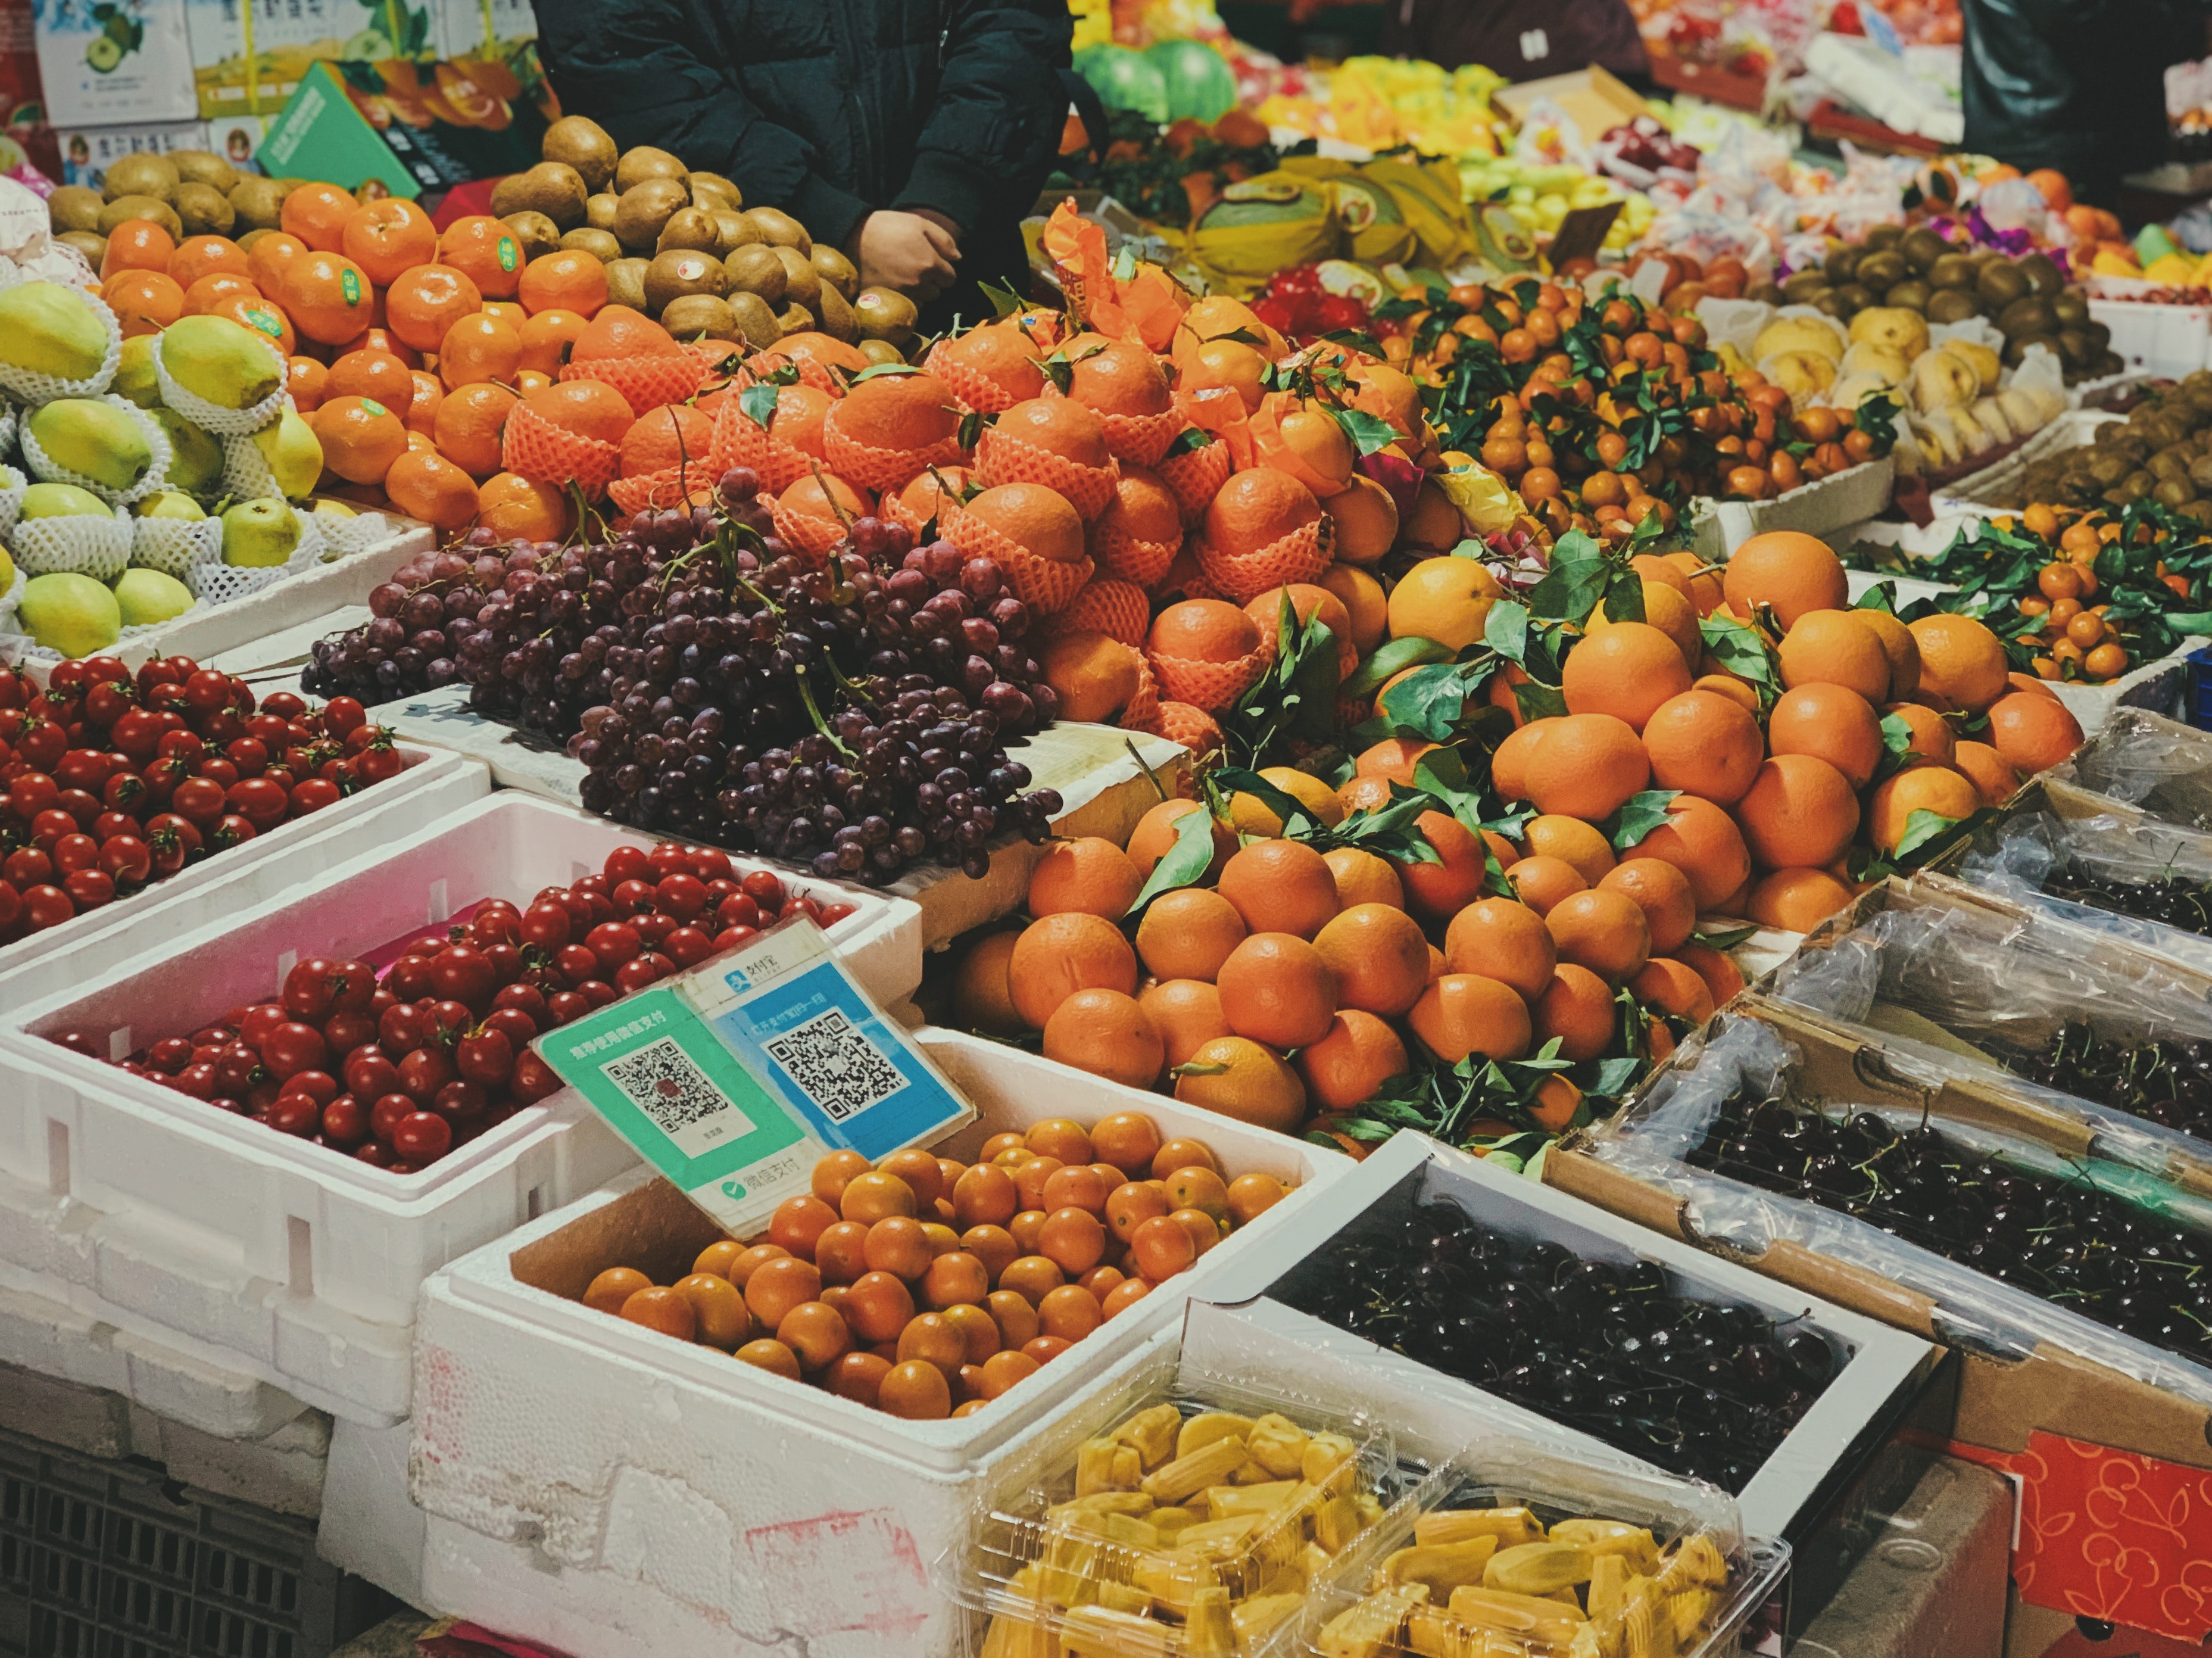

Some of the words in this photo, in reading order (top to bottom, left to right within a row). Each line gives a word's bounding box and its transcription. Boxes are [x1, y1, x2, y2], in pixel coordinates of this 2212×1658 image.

[745, 955, 778, 977] 支付宝
[569, 1010, 666, 1060] 推荐使用微信支付
[743, 1157, 800, 1190] 微信支付
